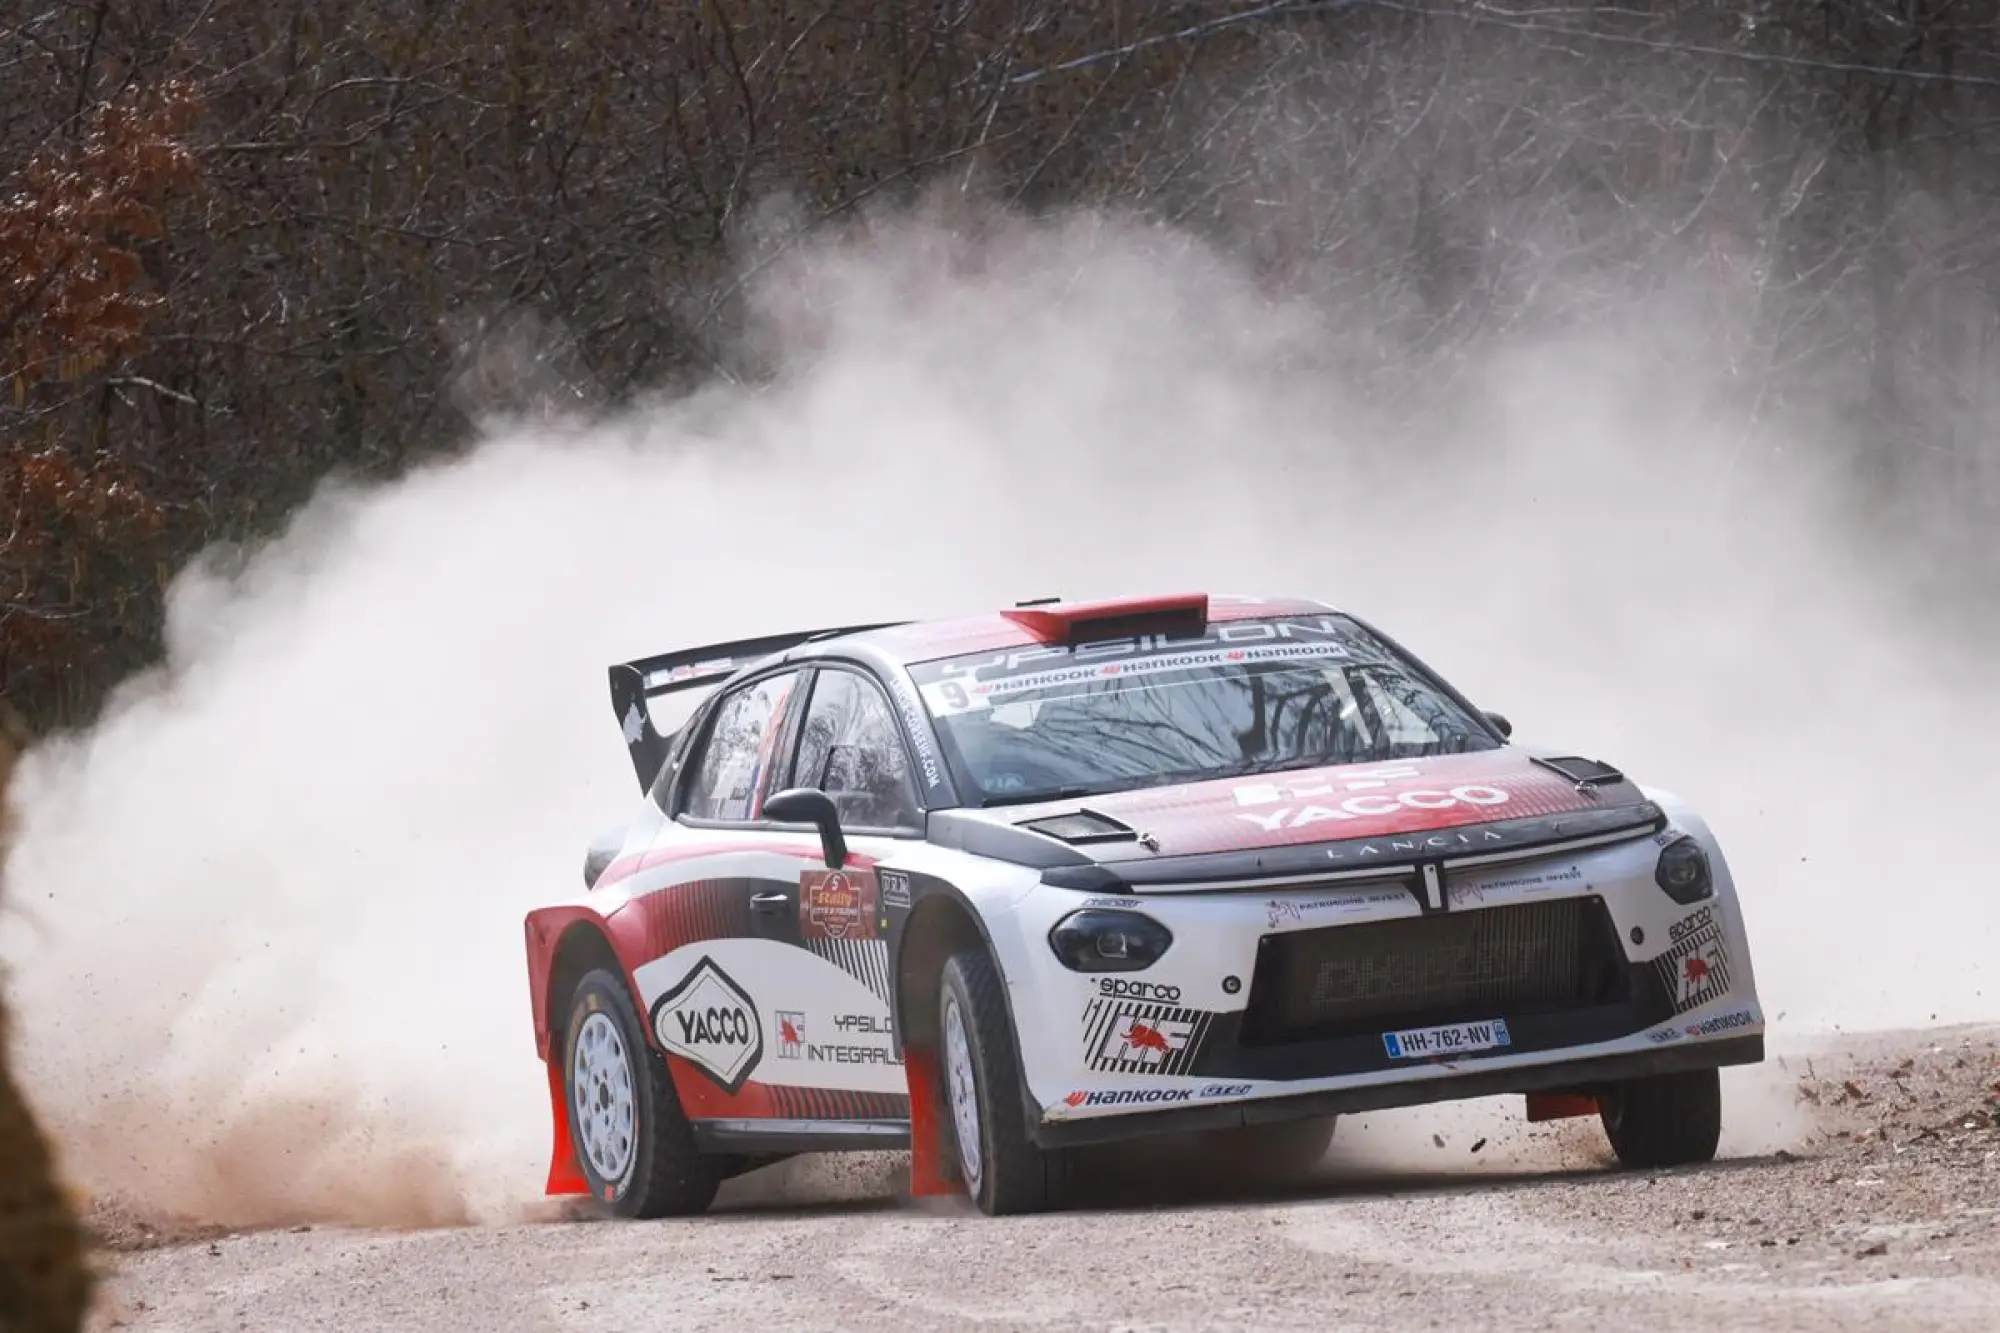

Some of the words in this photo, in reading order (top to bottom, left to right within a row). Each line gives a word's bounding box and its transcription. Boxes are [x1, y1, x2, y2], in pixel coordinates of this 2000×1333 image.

[940, 682, 970, 709] 9
[1236, 785, 1509, 830] YACCO
[1326, 831, 1502, 858] LANCIA
[1100, 978, 1181, 1000] sparco
[675, 1007, 749, 1045] YACCO
[834, 1015, 893, 1033] YPSILO
[1401, 1025, 1491, 1052] HH-762-NV
